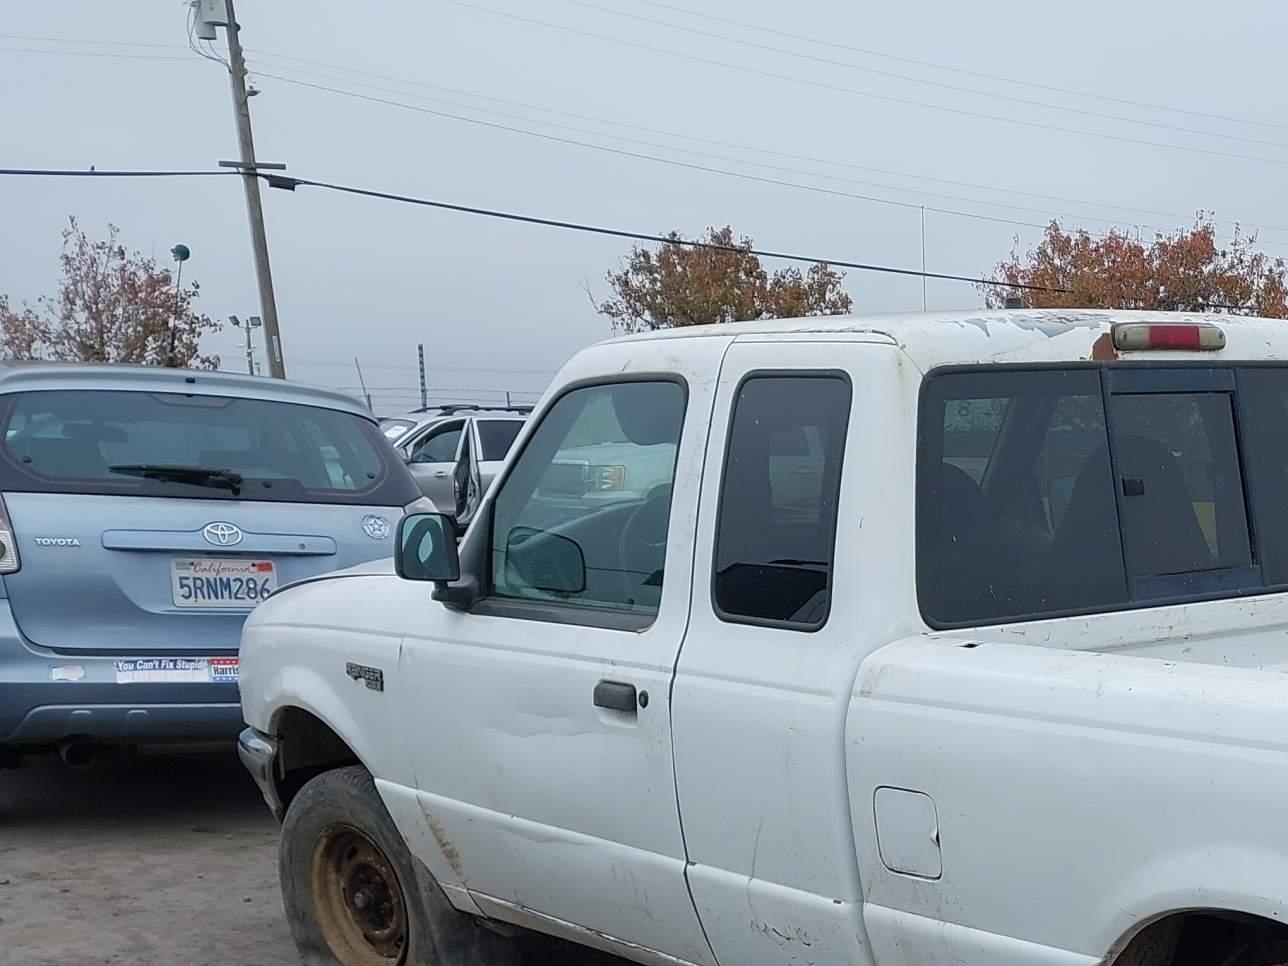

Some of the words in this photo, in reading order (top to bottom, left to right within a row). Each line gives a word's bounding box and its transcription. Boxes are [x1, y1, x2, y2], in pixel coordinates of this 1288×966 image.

[35, 538, 80, 546] TOYOTA
[193, 562, 256, 576] California
[179, 576, 271, 601] 5RNM286
[118, 661, 134, 670] You
[136, 660, 159, 669] Can't
[161, 660, 174, 669] Fix
